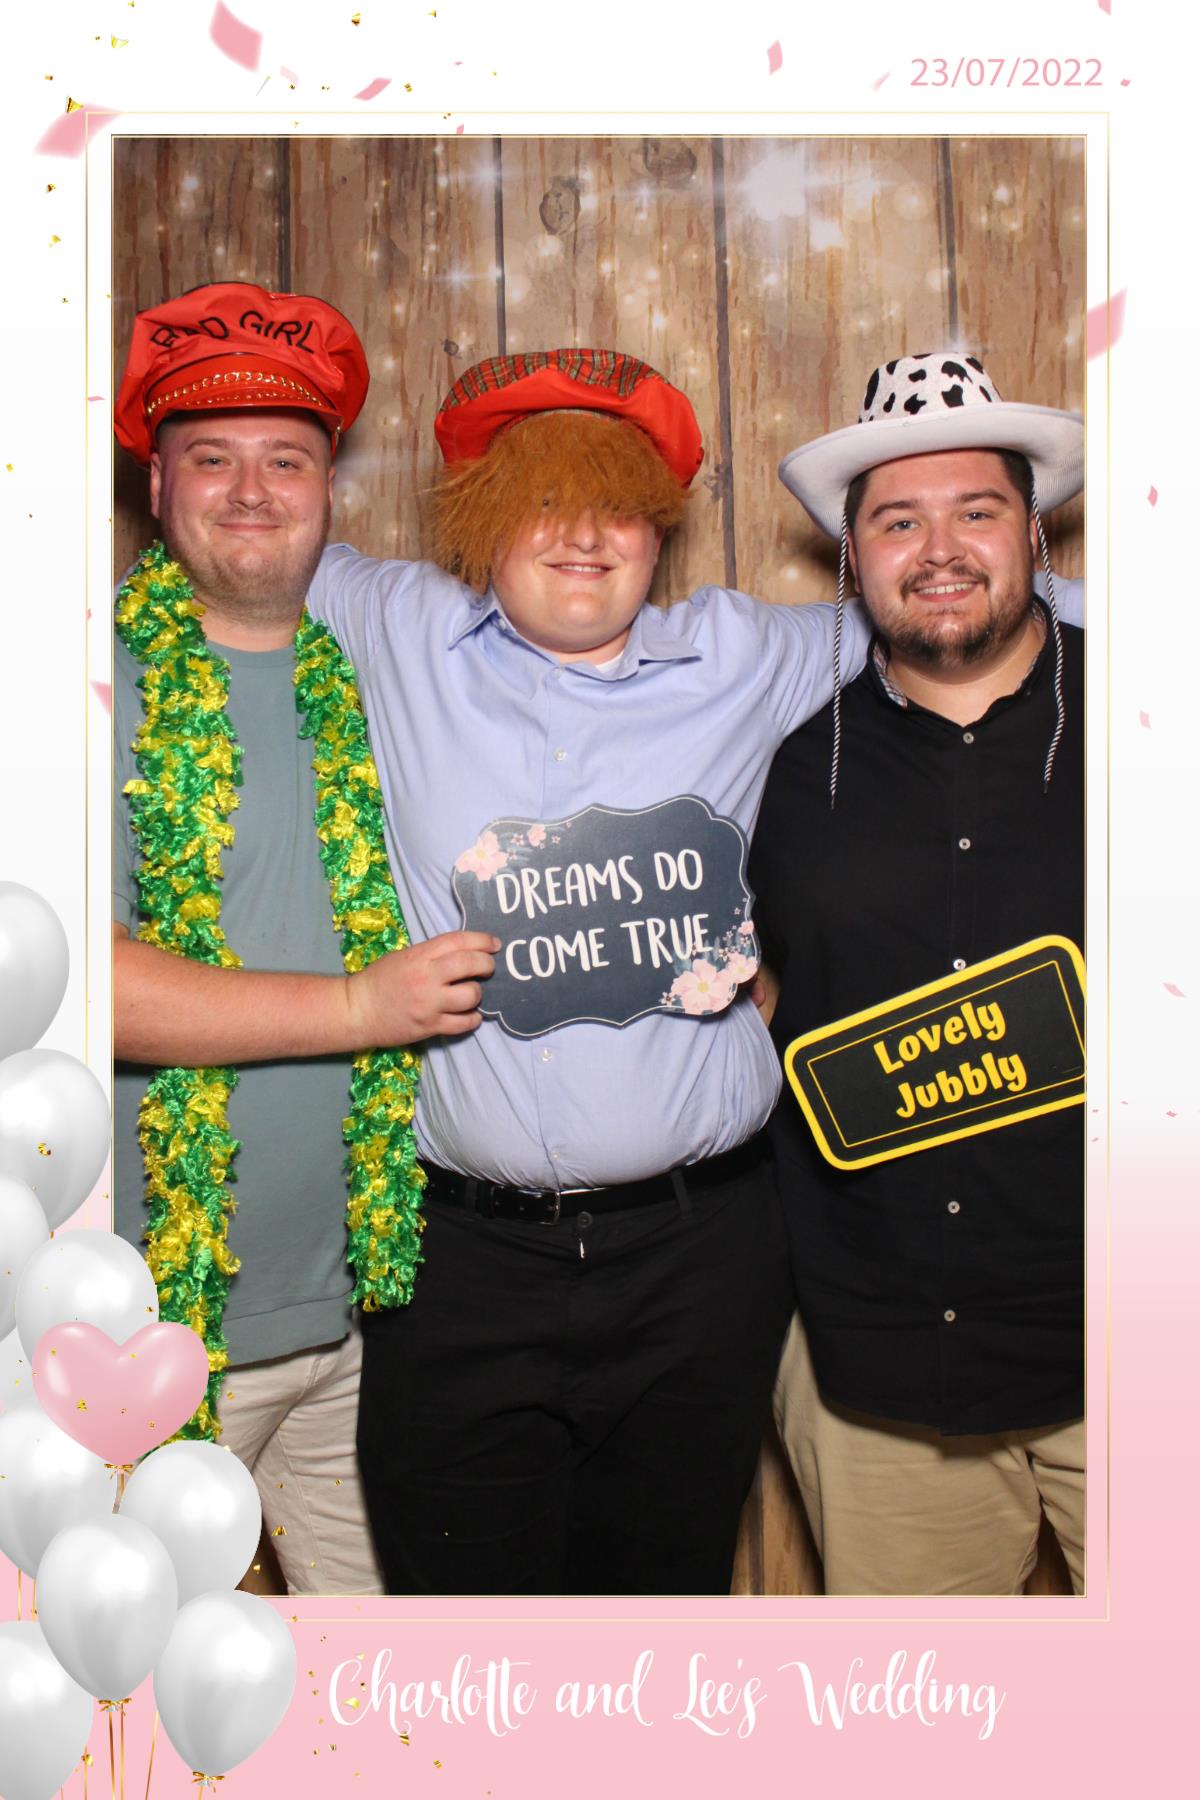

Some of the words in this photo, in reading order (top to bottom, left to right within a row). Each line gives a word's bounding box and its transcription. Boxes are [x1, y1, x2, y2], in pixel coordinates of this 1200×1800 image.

[239, 310, 315, 354] GIRL
[495, 855, 643, 919] DREAMS
[654, 848, 703, 891] DO
[505, 927, 610, 984] COME
[620, 913, 714, 969] TRUE
[873, 1001, 1007, 1074] Lovely
[896, 1052, 1028, 1118] Jubbly
